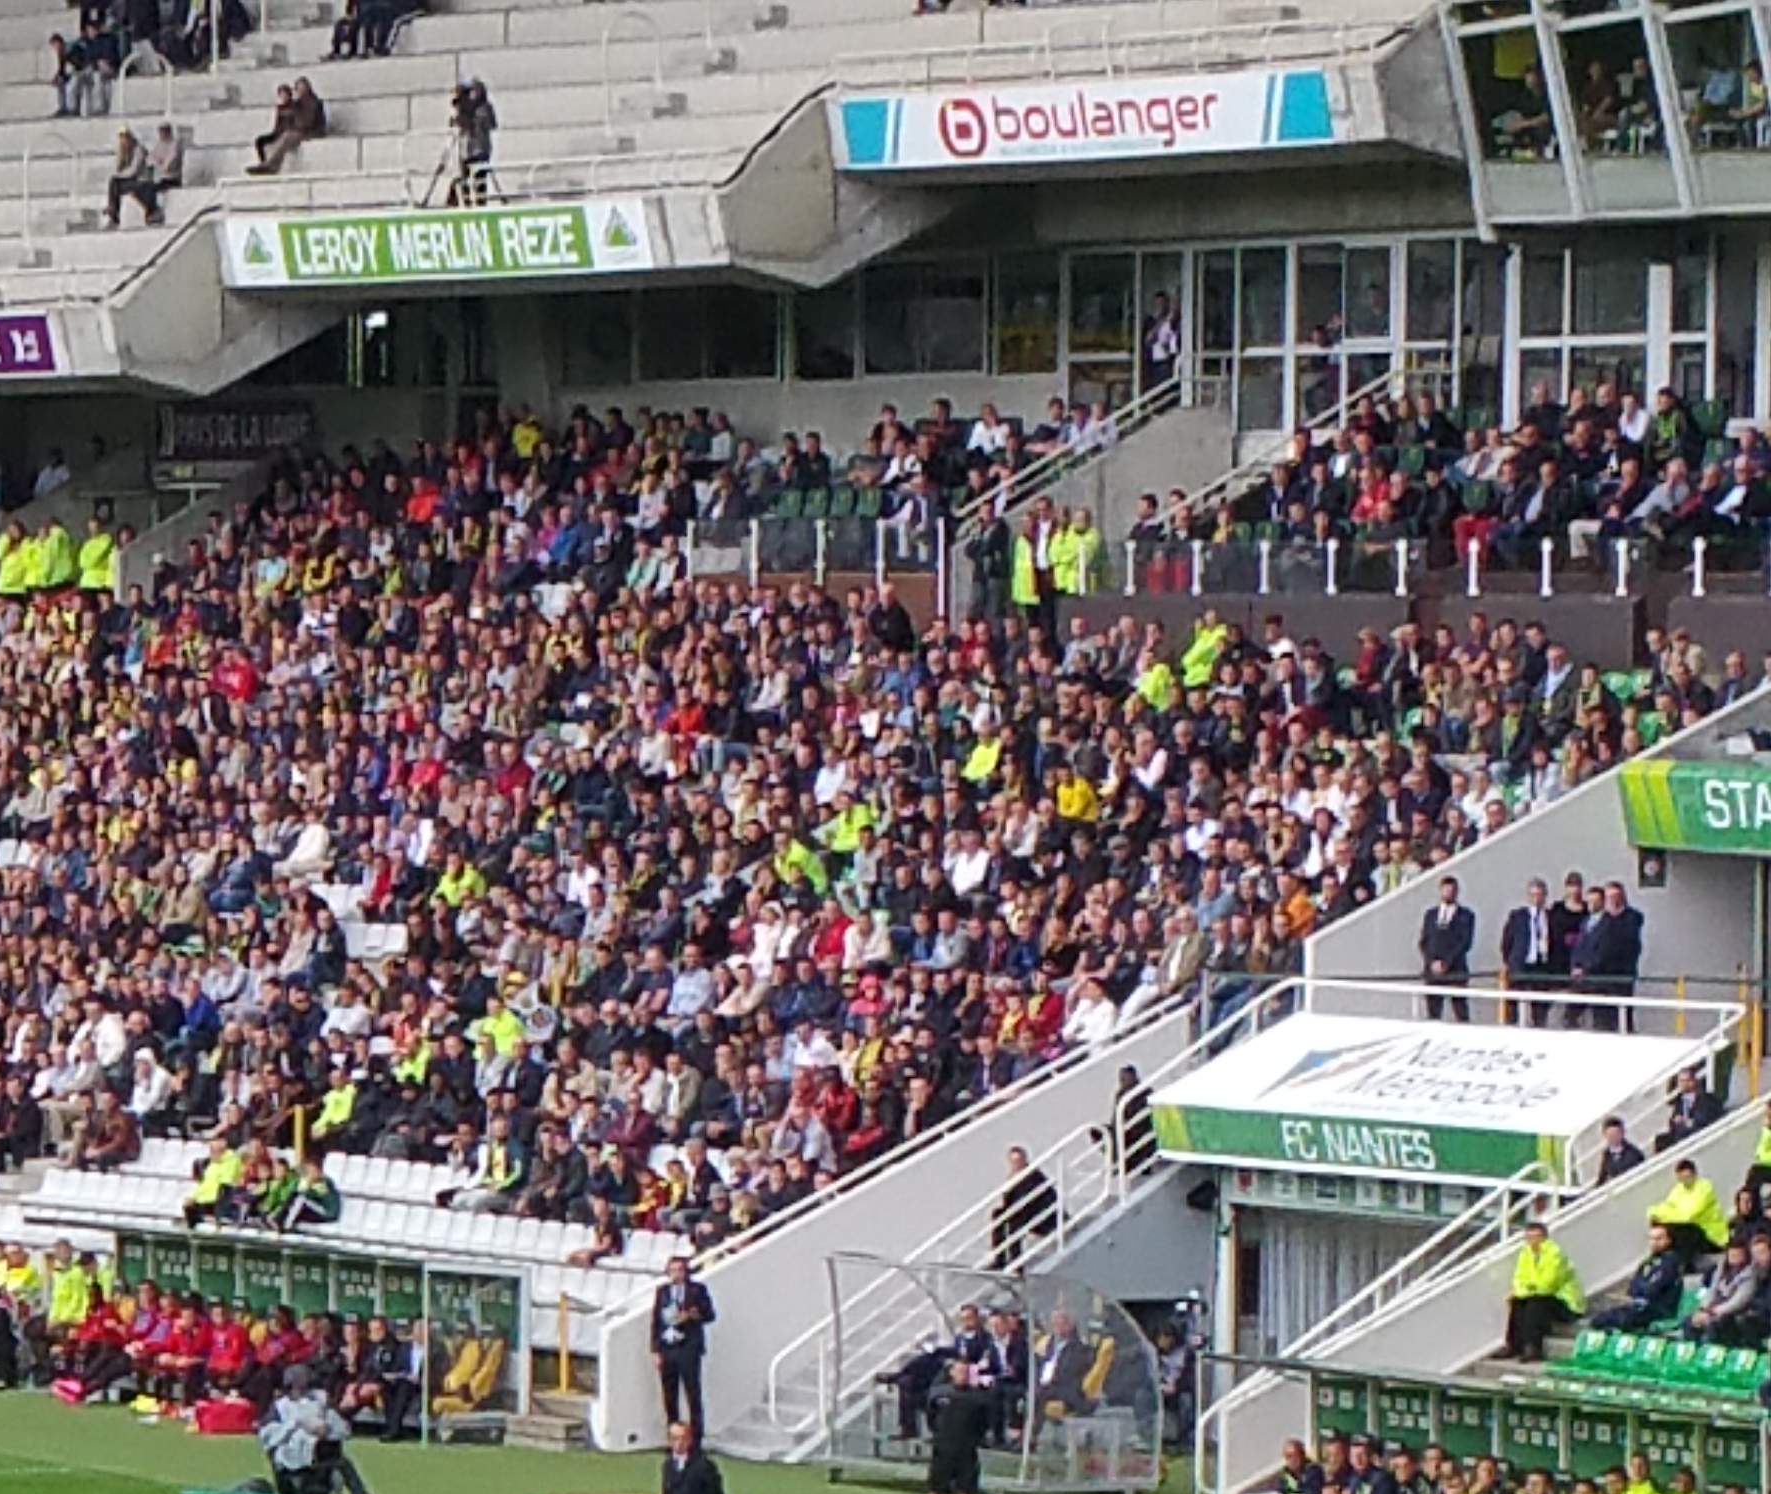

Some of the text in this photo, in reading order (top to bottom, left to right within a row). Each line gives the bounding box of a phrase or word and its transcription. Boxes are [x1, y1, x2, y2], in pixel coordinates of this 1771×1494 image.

[992, 92, 1218, 148] boulanger
[291, 213, 579, 275] LEROY MERLIN REZE
[1280, 1119, 1437, 1171] FC NANTES
